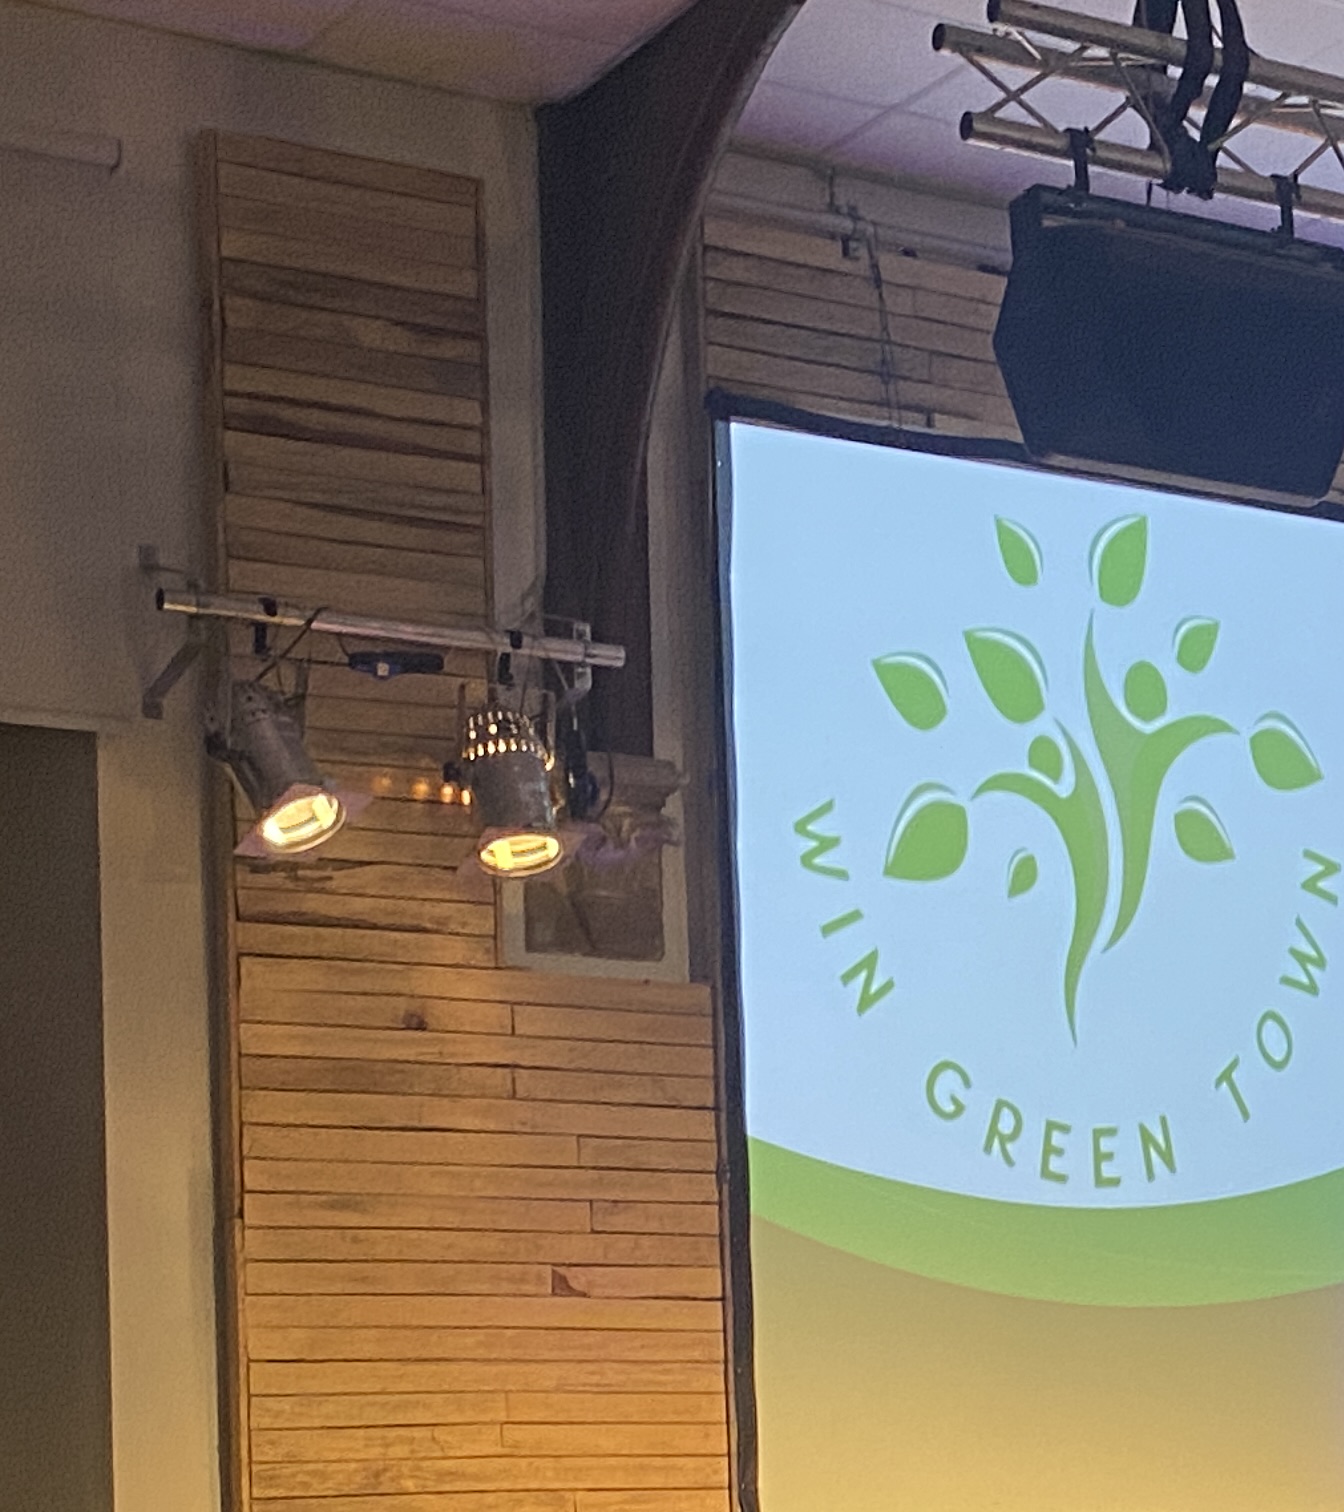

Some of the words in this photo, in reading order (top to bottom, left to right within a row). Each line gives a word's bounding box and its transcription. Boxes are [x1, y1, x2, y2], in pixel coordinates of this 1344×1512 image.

[793, 798, 895, 1017] WIN
[925, 1059, 1177, 1188] GREEN
[1214, 847, 1342, 1123] TOWN
